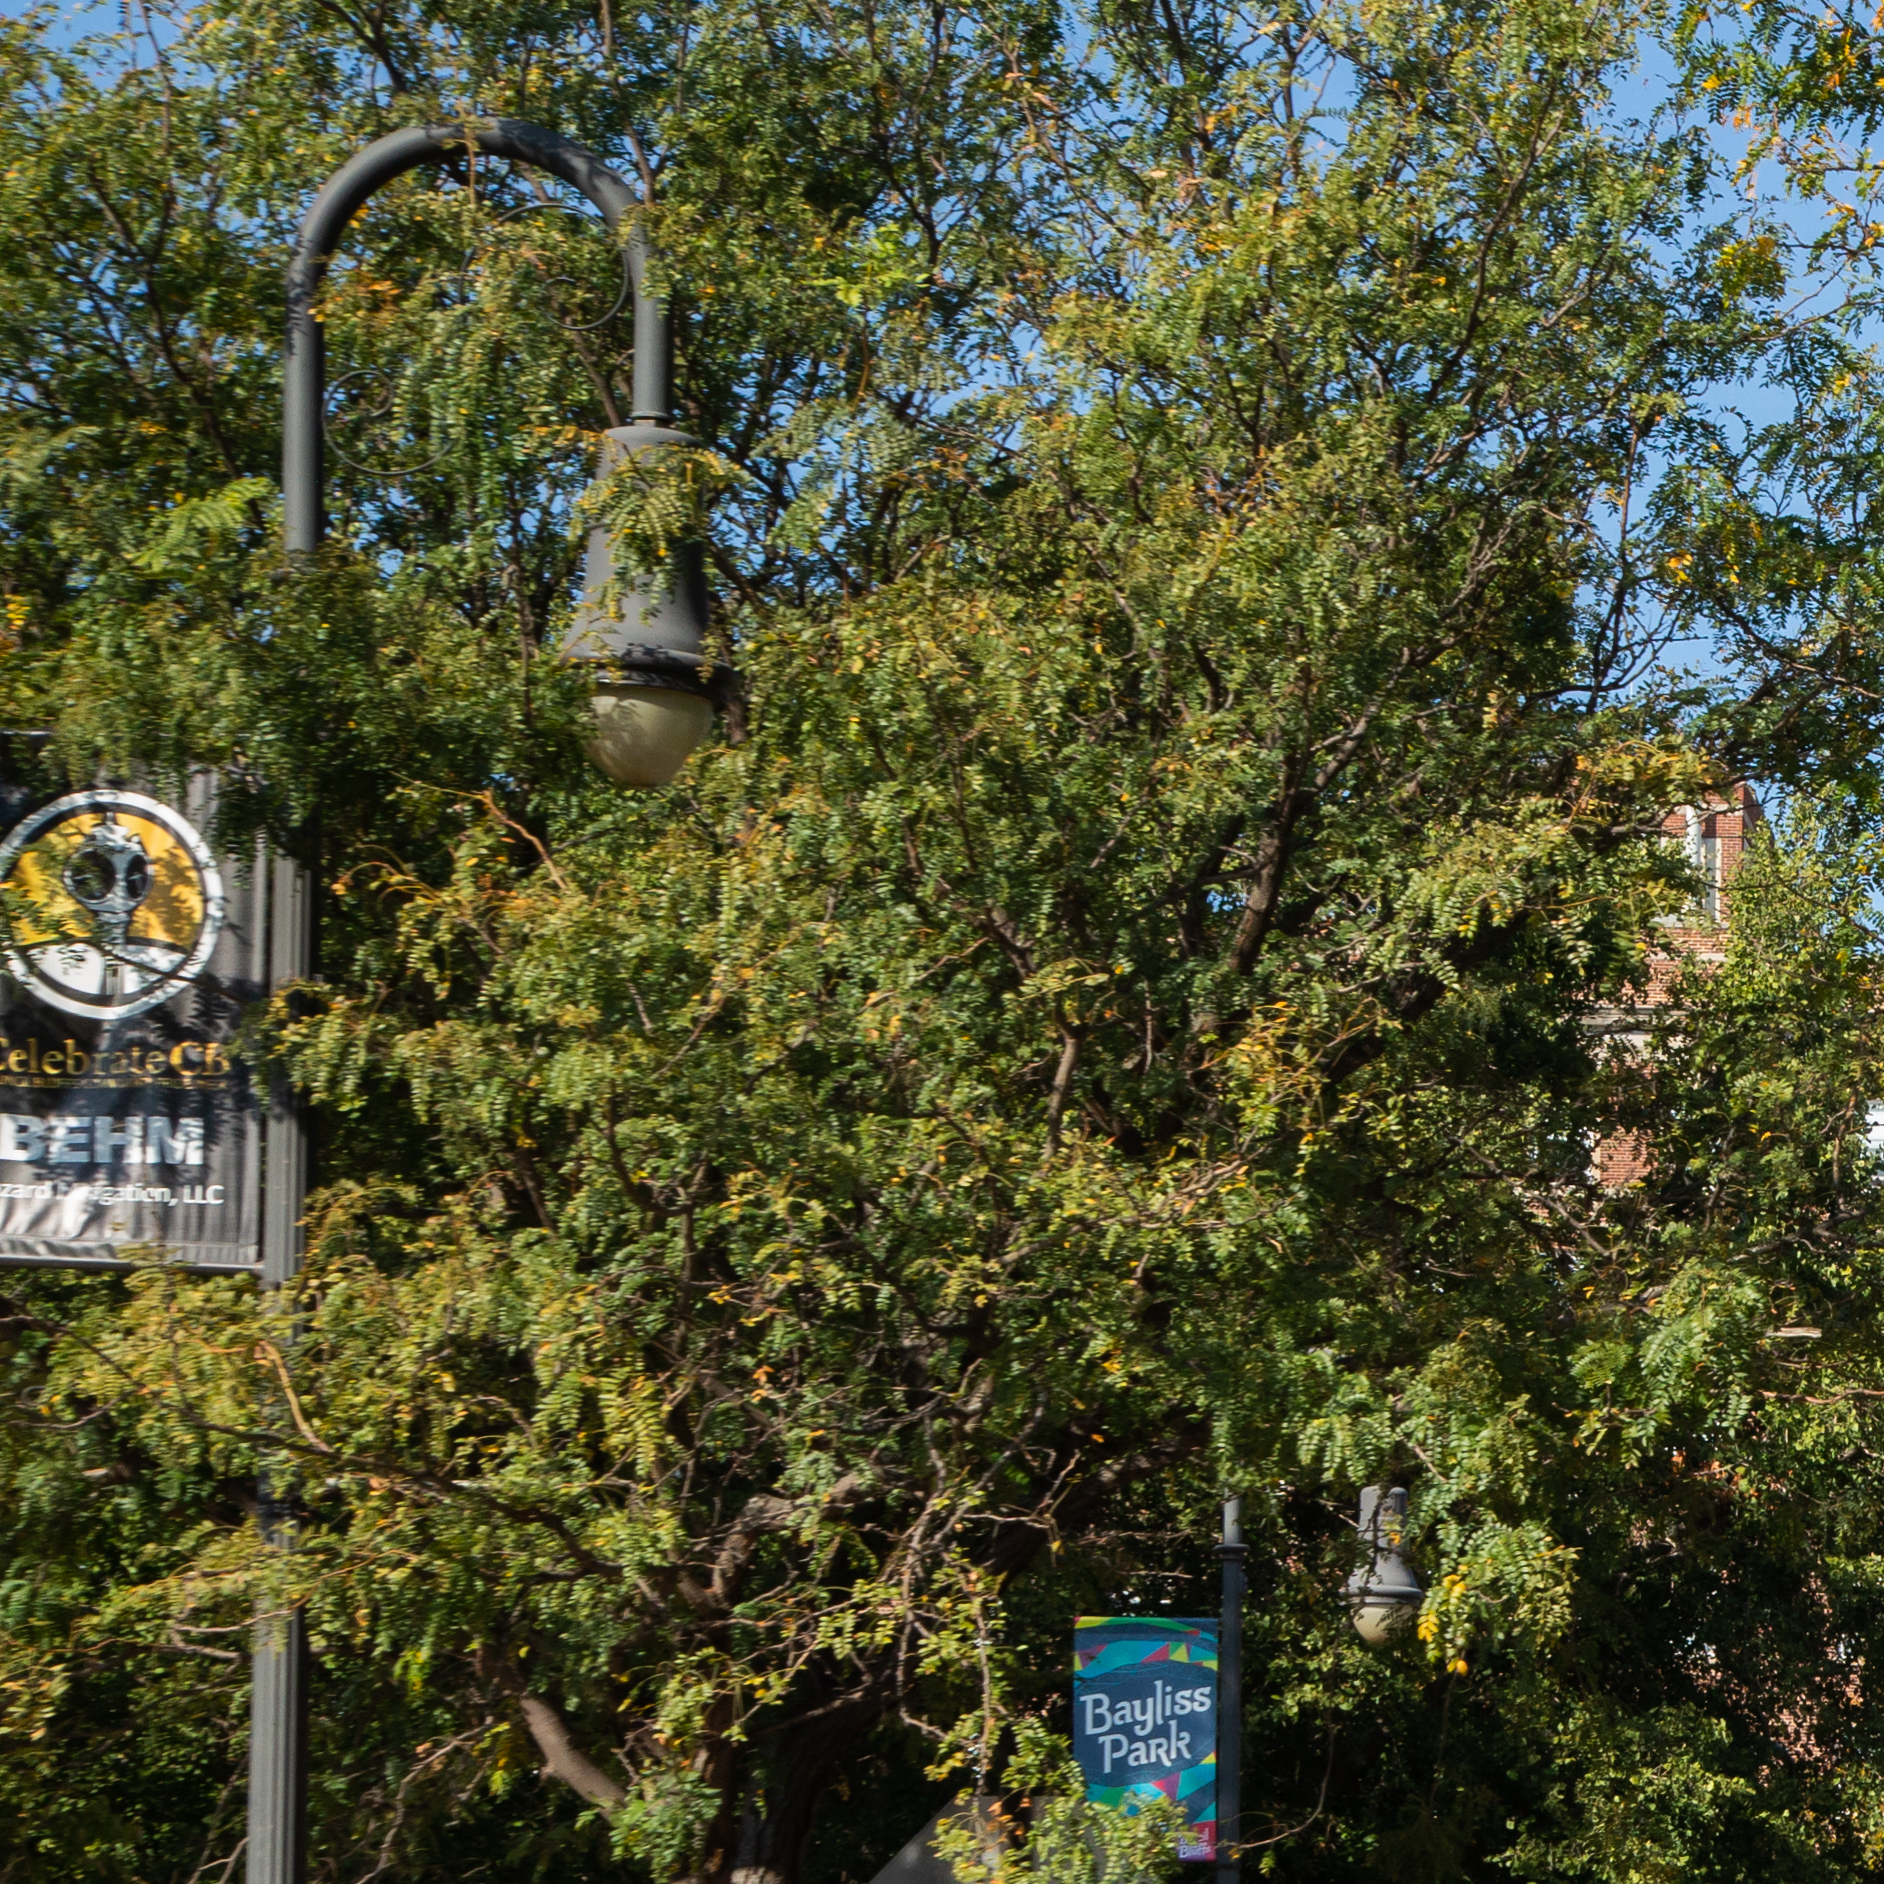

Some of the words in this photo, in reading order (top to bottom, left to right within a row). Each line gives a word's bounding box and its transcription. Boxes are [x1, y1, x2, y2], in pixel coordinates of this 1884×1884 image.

[0, 1112, 205, 1166] BEHM
[183, 1185, 225, 1206] LLC
[1079, 1680, 1212, 1737] Bayliss
[1098, 1719, 1192, 1775] Park
